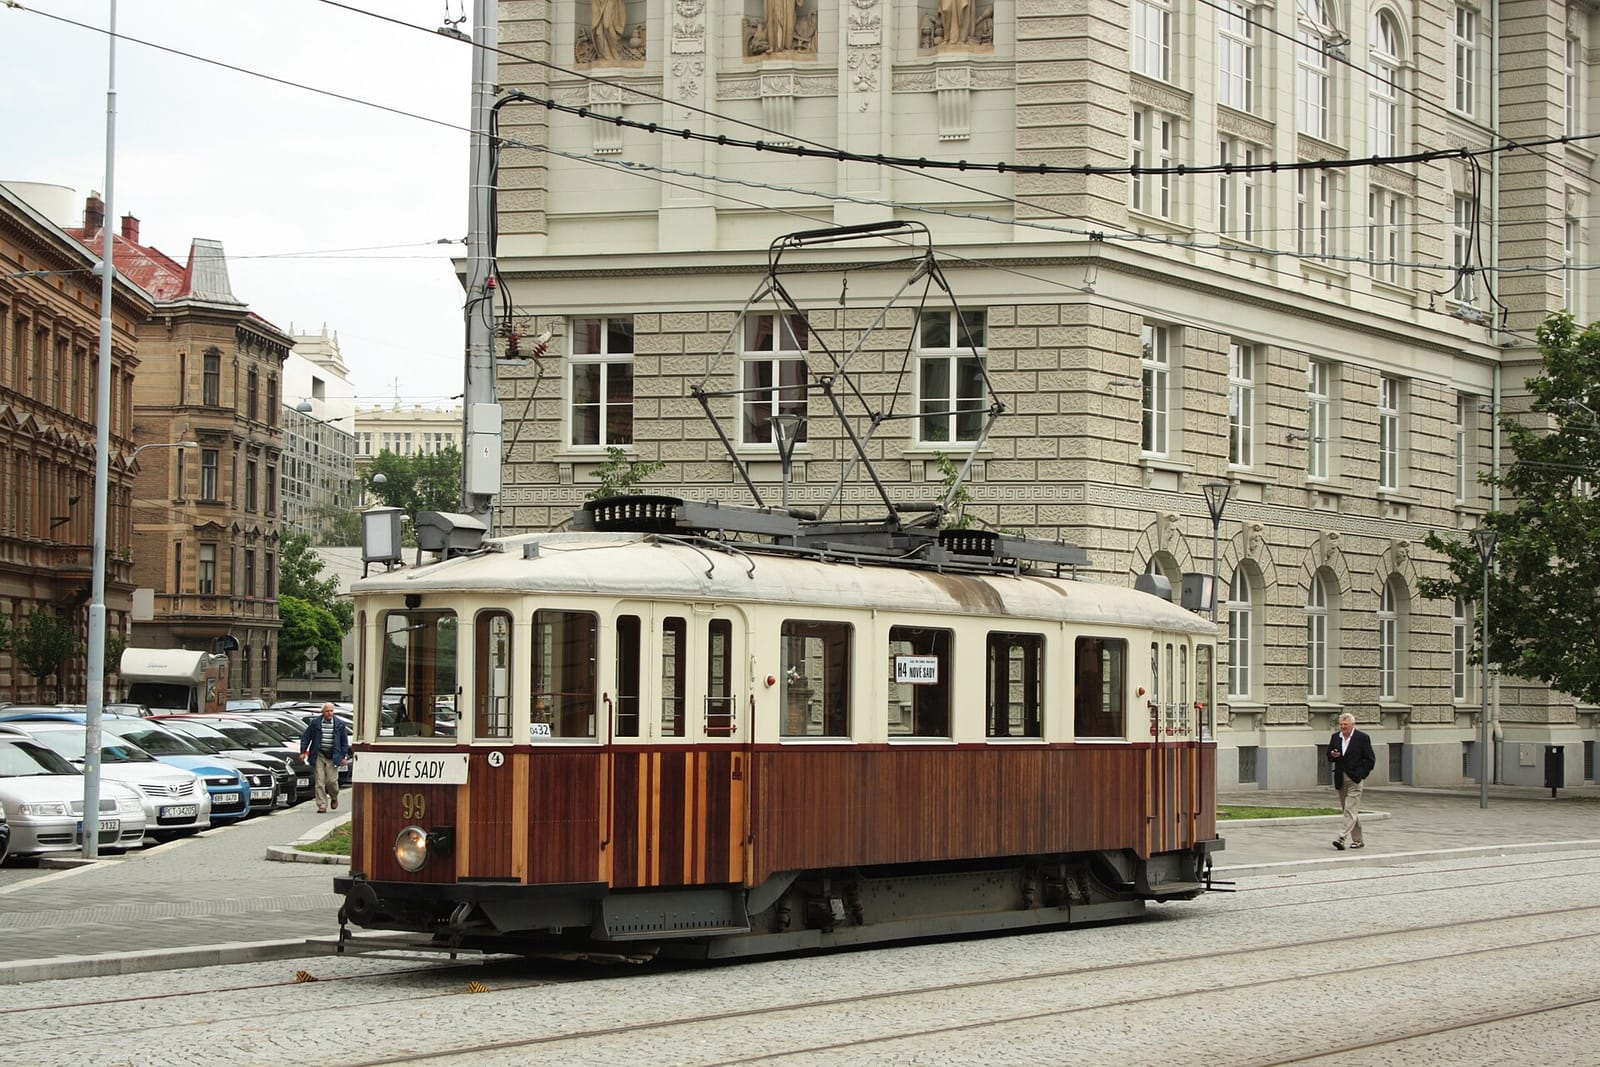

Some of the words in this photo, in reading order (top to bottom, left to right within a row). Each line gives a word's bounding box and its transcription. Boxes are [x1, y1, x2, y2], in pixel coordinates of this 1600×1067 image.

[897, 662, 907, 678] H4
[922, 667, 935, 678] SADY
[491, 752, 501, 764] 4
[378, 755, 412, 778] NOVÉ
[414, 760, 445, 779] SADY
[402, 793, 426, 819] 99
